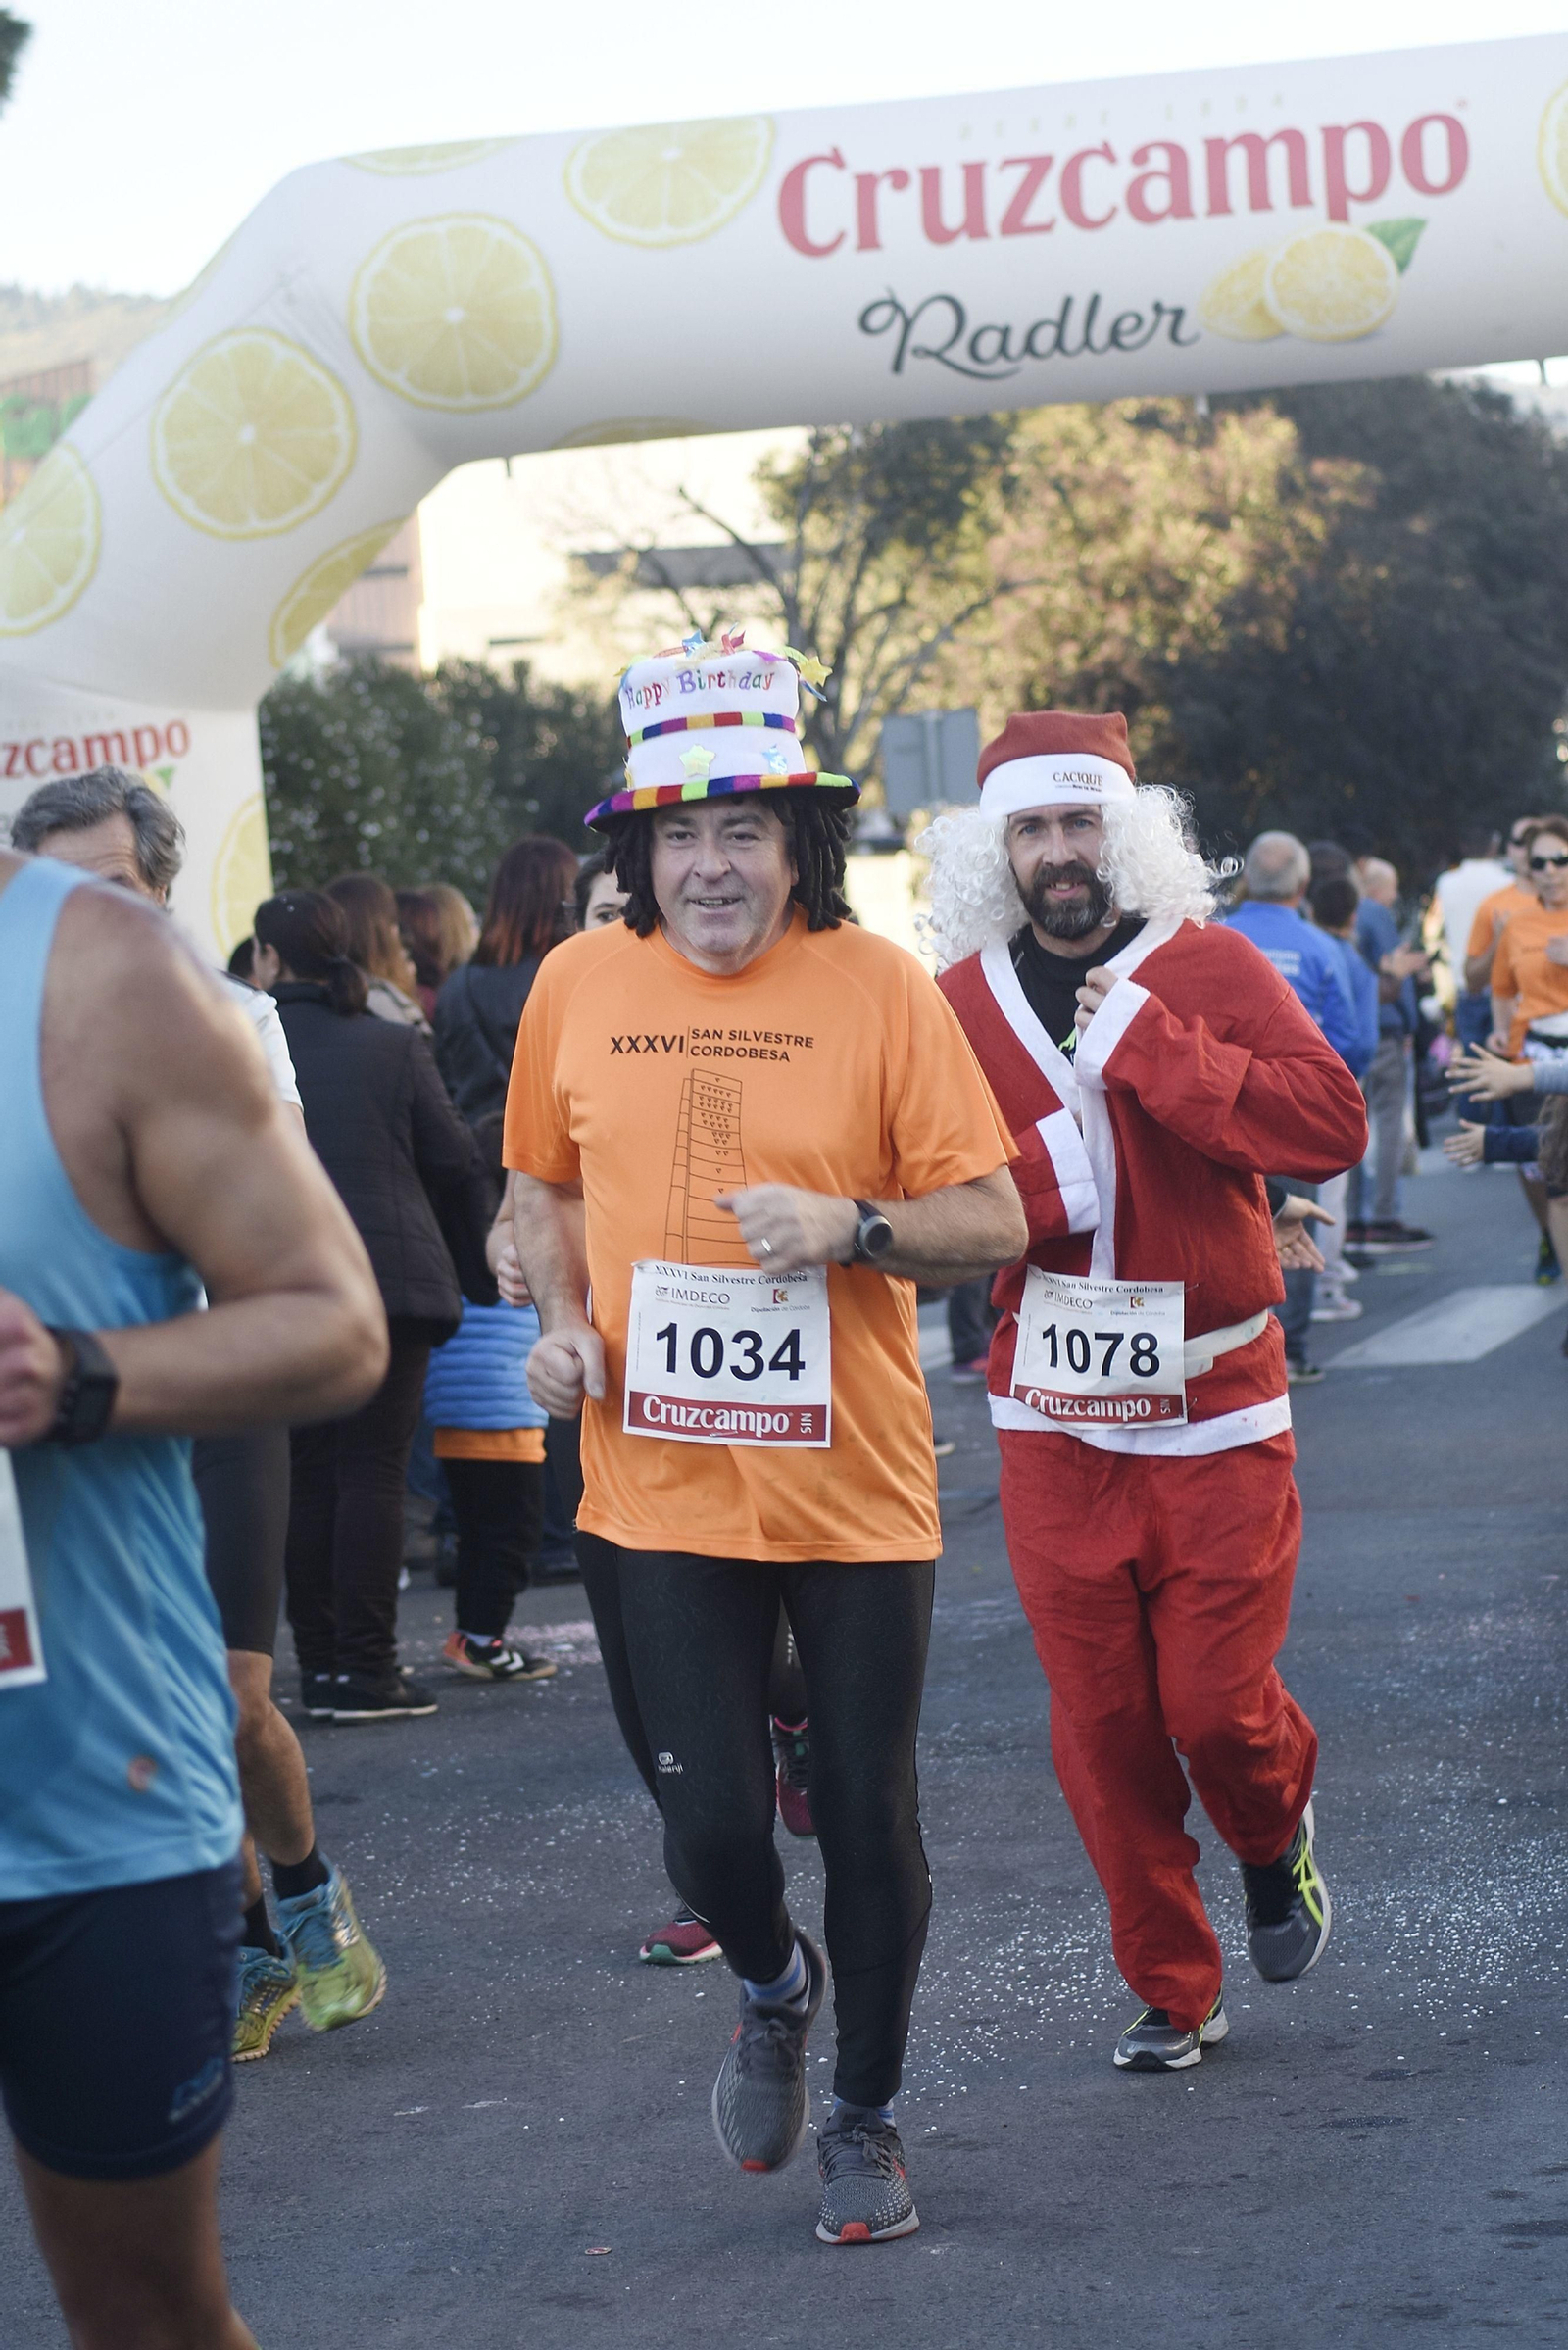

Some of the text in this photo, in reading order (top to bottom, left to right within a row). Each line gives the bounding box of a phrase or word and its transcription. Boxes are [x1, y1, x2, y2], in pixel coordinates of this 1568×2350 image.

[778, 112, 1470, 257] Cruzcampo
[858, 286, 1201, 379] Radler
[624, 669, 775, 709] Happy Birthday
[0, 718, 192, 780] zcampo
[1053, 771, 1103, 787] CACIQUE
[610, 1035, 684, 1054] XXXVI
[691, 1028, 814, 1049] SAN SILVESTRE
[690, 1046, 790, 1062] CORDOBESA
[690, 1272, 710, 1283] San
[711, 1274, 756, 1285] Silvestre
[758, 1273, 808, 1285] Cordobesa
[1061, 1280, 1076, 1289] San
[1079, 1282, 1113, 1293] Silvestre
[671, 1287, 731, 1304] IMDECO
[1054, 1291, 1093, 1310] IMDECO
[656, 1322, 806, 1381] 1034
[1042, 1324, 1160, 1377] 1078
[1025, 1388, 1152, 1422] Cruzcampo
[1161, 1398, 1171, 1414] SIN
[642, 1395, 790, 1437] Cruzcampo
[800, 1412, 812, 1434] SIN
